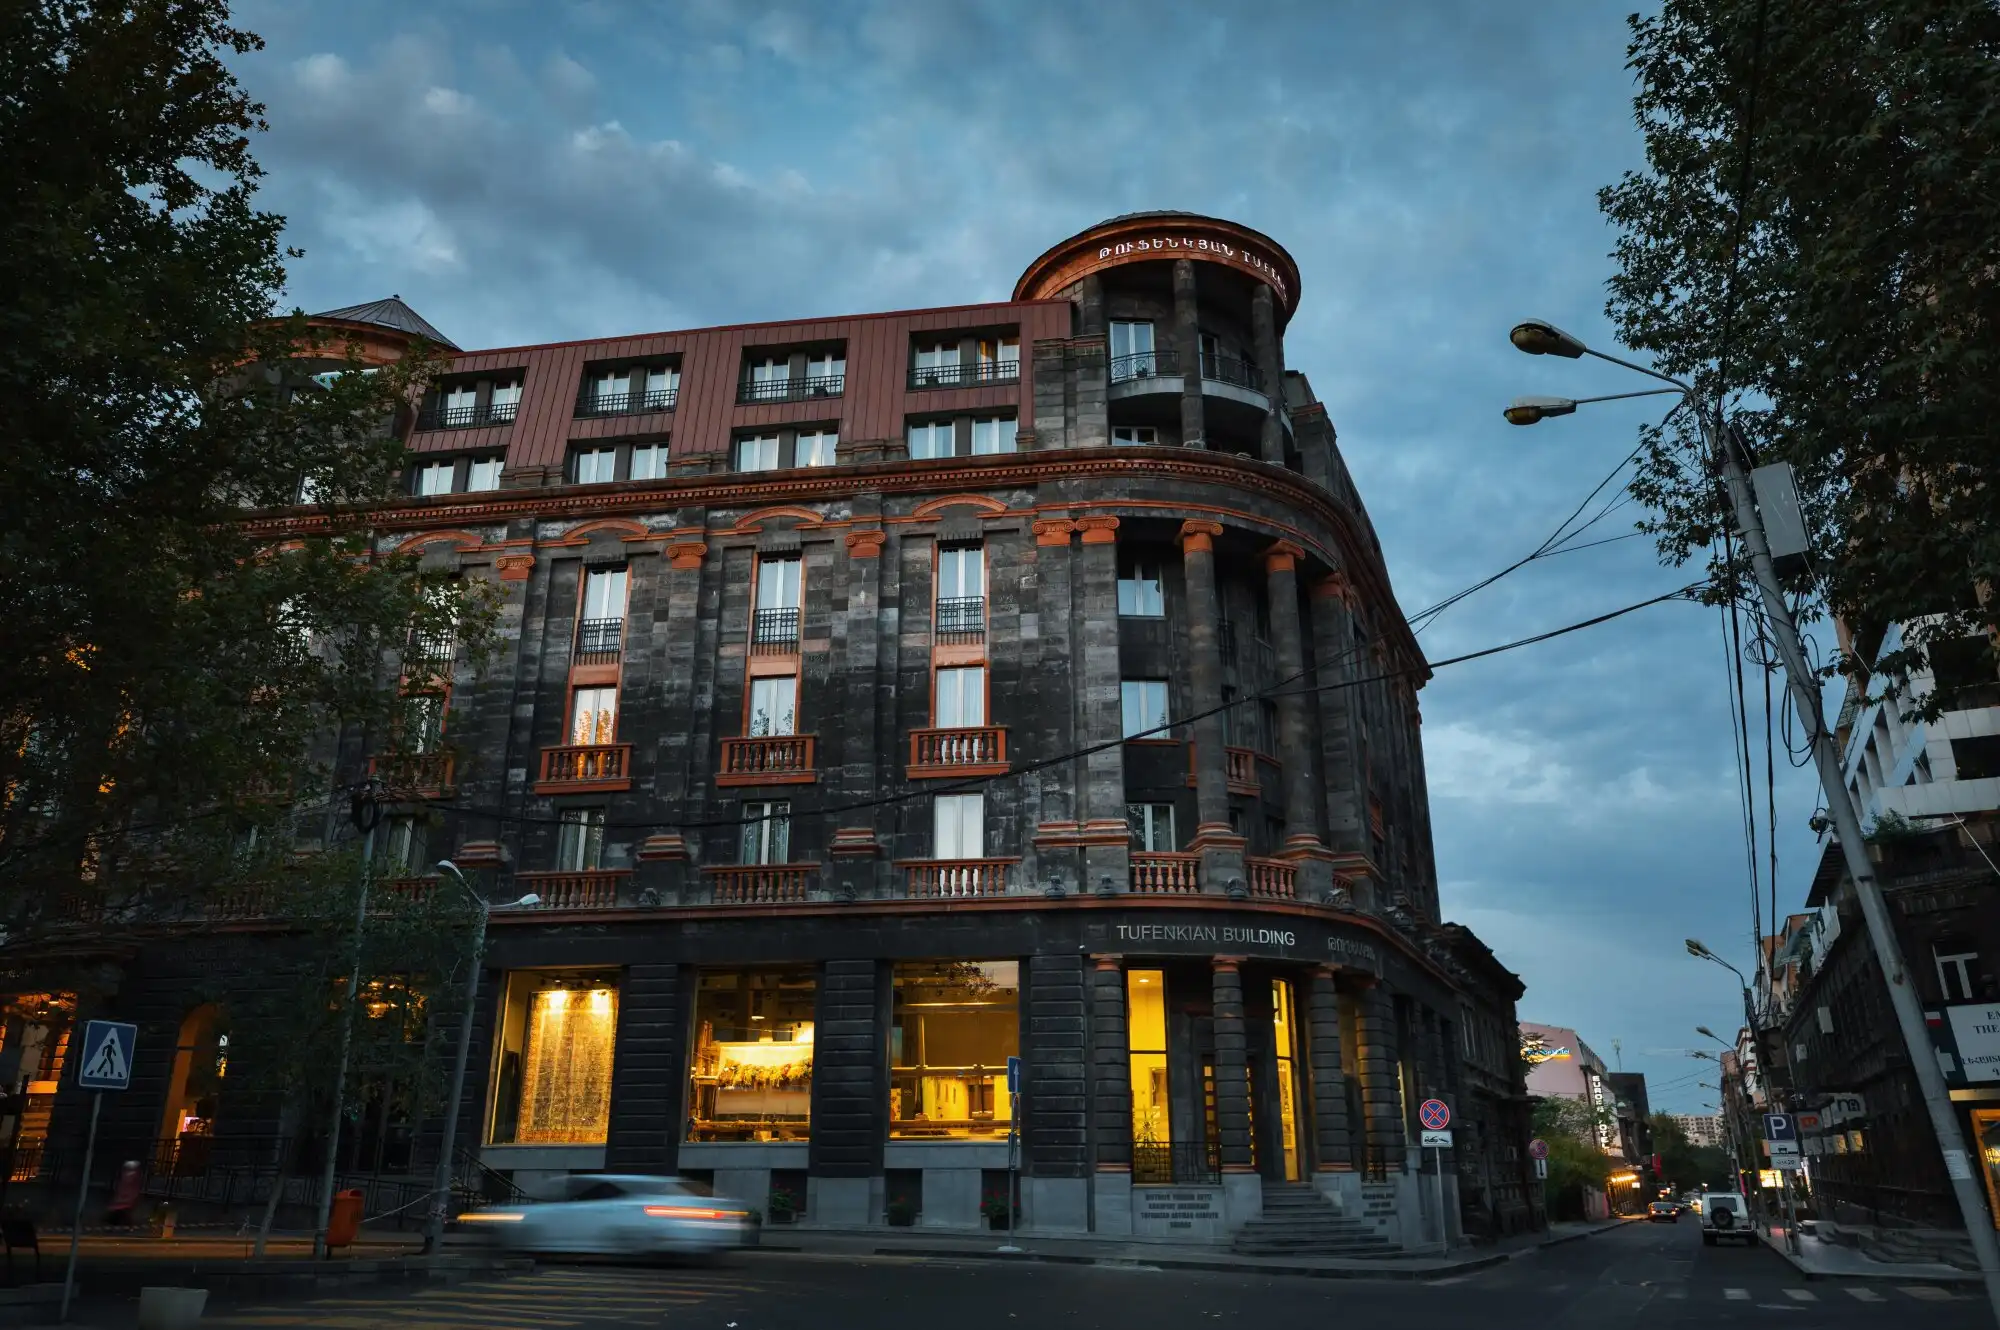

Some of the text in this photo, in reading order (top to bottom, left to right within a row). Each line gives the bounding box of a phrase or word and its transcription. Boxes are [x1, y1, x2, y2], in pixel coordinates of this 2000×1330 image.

[1116, 925, 1296, 947] TUFENKIAN BUILDING
[1972, 1024, 2000, 1034] THE
[1598, 1119, 1610, 1149] OTEL
[1769, 1116, 1787, 1139] P
